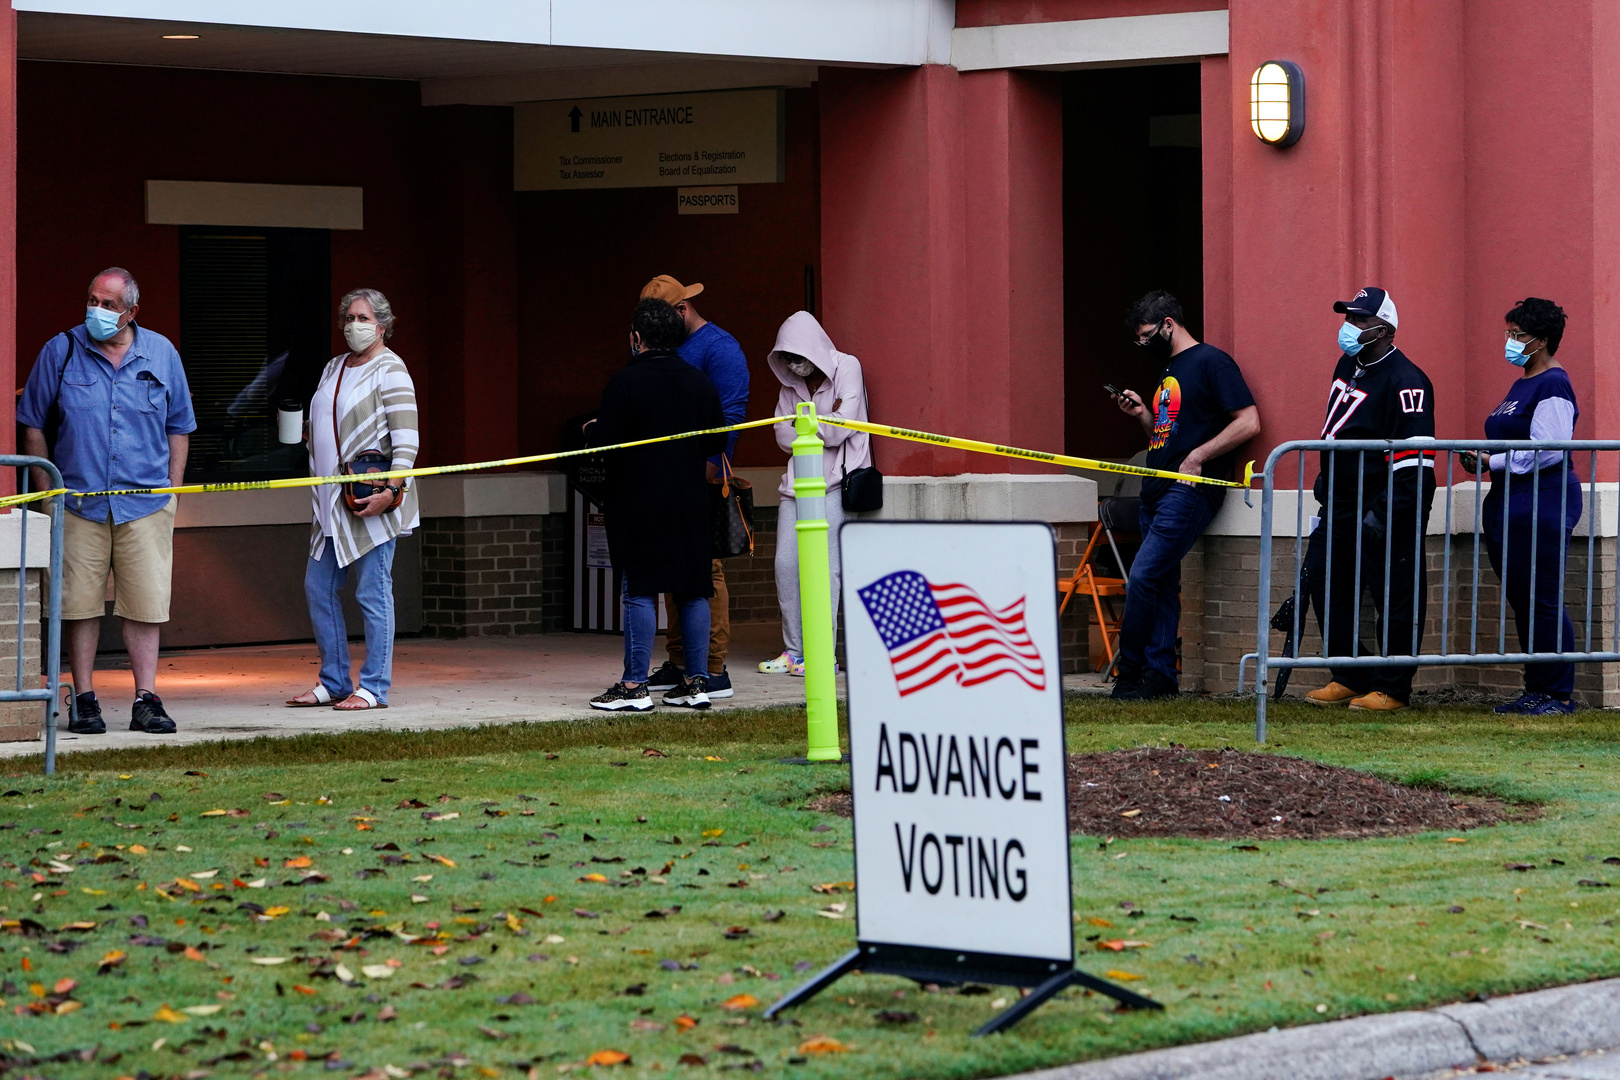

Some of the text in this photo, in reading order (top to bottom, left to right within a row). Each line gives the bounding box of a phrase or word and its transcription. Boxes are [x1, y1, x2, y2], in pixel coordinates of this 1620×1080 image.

[591, 107, 694, 128] MAIN ENTRANCE
[559, 155, 623, 166] Tax Commissioner
[659, 151, 745, 162] Elections & Registration
[559, 170, 605, 179] Tax Assessor
[659, 165, 736, 176] Board of Equalization
[679, 194, 736, 206] PASSPORTS
[1321, 377, 1369, 440] 07
[1399, 389, 1425, 413] 07
[876, 722, 1042, 802] ADVANCE
[895, 822, 1028, 902] VOTING
